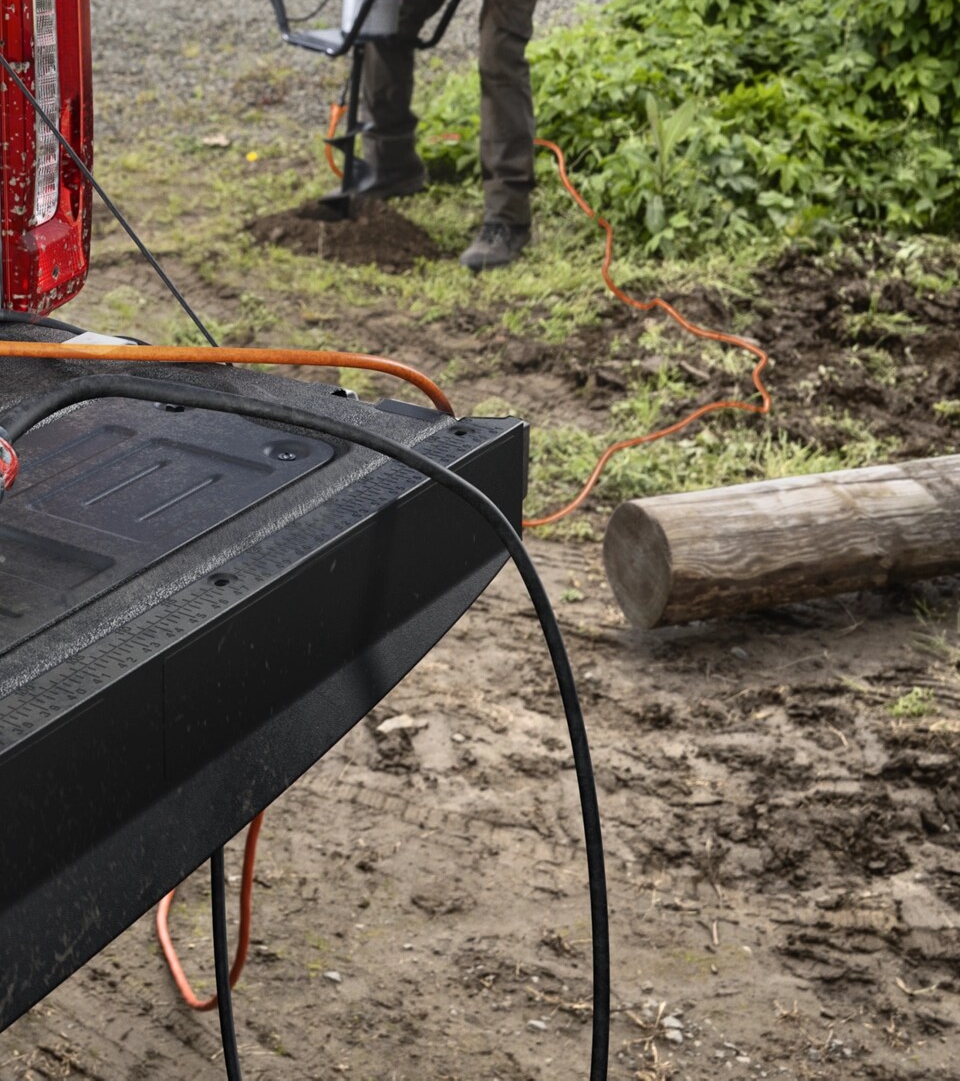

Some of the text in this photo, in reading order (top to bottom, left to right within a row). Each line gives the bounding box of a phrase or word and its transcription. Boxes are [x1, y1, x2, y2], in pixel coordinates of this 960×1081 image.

[12, 721, 34, 735] 38
[39, 705, 61, 718] 39
[67, 688, 87, 700] 40
[92, 672, 112, 685] 41
[118, 657, 138, 669] 42
[142, 642, 161, 653] 43
[166, 627, 184, 638] 44
[189, 613, 207, 624] 45
[211, 599, 229, 609] 46
